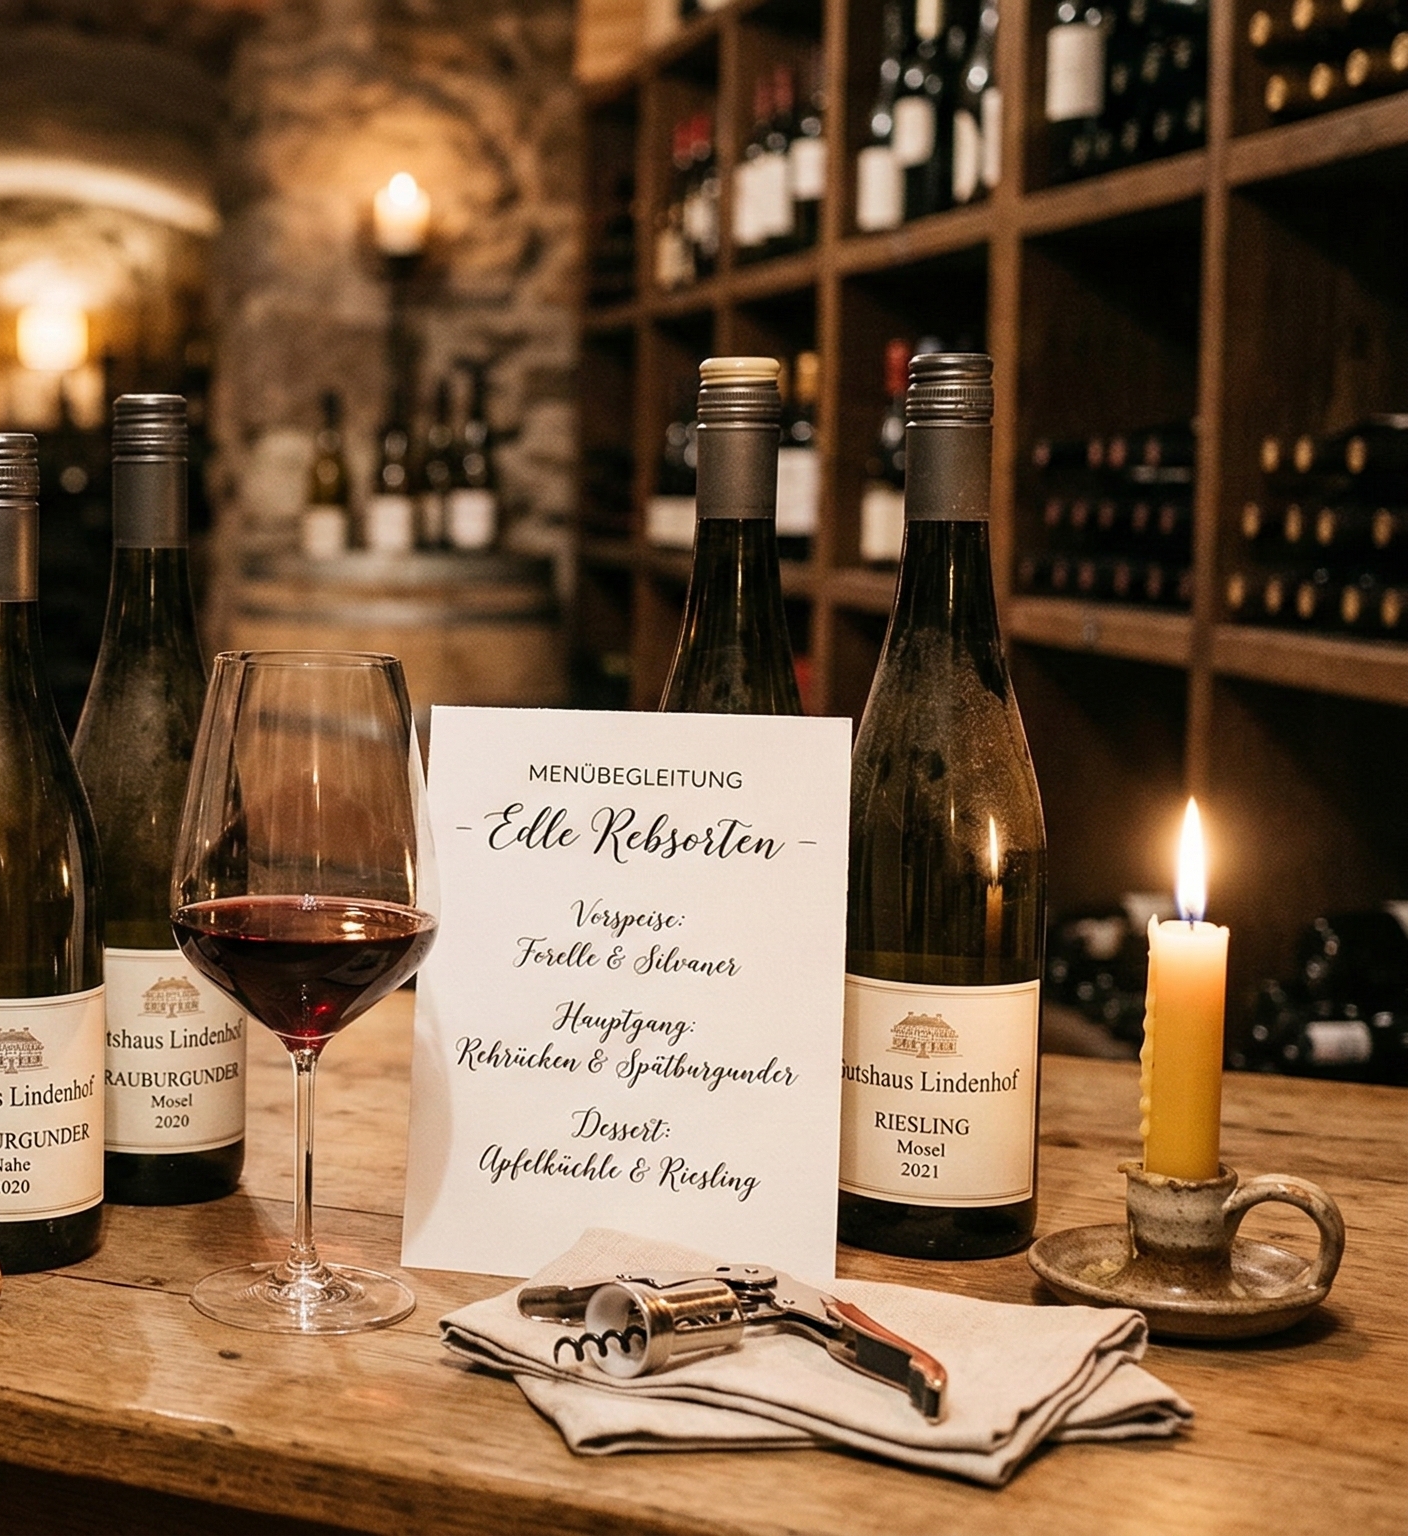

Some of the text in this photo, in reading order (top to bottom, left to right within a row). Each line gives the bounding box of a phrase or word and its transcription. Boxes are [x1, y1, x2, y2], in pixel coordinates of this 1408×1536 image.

[529, 763, 743, 789] MENÜBEGLEITUNG
[483, 802, 785, 864] Edle Rebsorten
[570, 898, 686, 938] Vorspeise:
[513, 936, 742, 977] Forelle & Silvaner
[552, 1000, 696, 1046] Hauptgang:
[106, 1029, 164, 1049] tshaus
[104, 1062, 239, 1088] RAUBURGUNDER
[455, 1036, 800, 1092] Rehrücken & Spätburgunder
[9, 1074, 96, 1107] Lindenhof
[920, 1068, 1020, 1093] Lindenhof
[151, 1093, 193, 1108] Mosel
[155, 1114, 190, 1128] 2020
[571, 1106, 671, 1142] Dessert:
[874, 1111, 970, 1136] RIESLING
[897, 1139, 946, 1157] Mosel
[479, 1144, 761, 1203] Apfelküchle & Riesling
[900, 1162, 939, 1179] 2021
